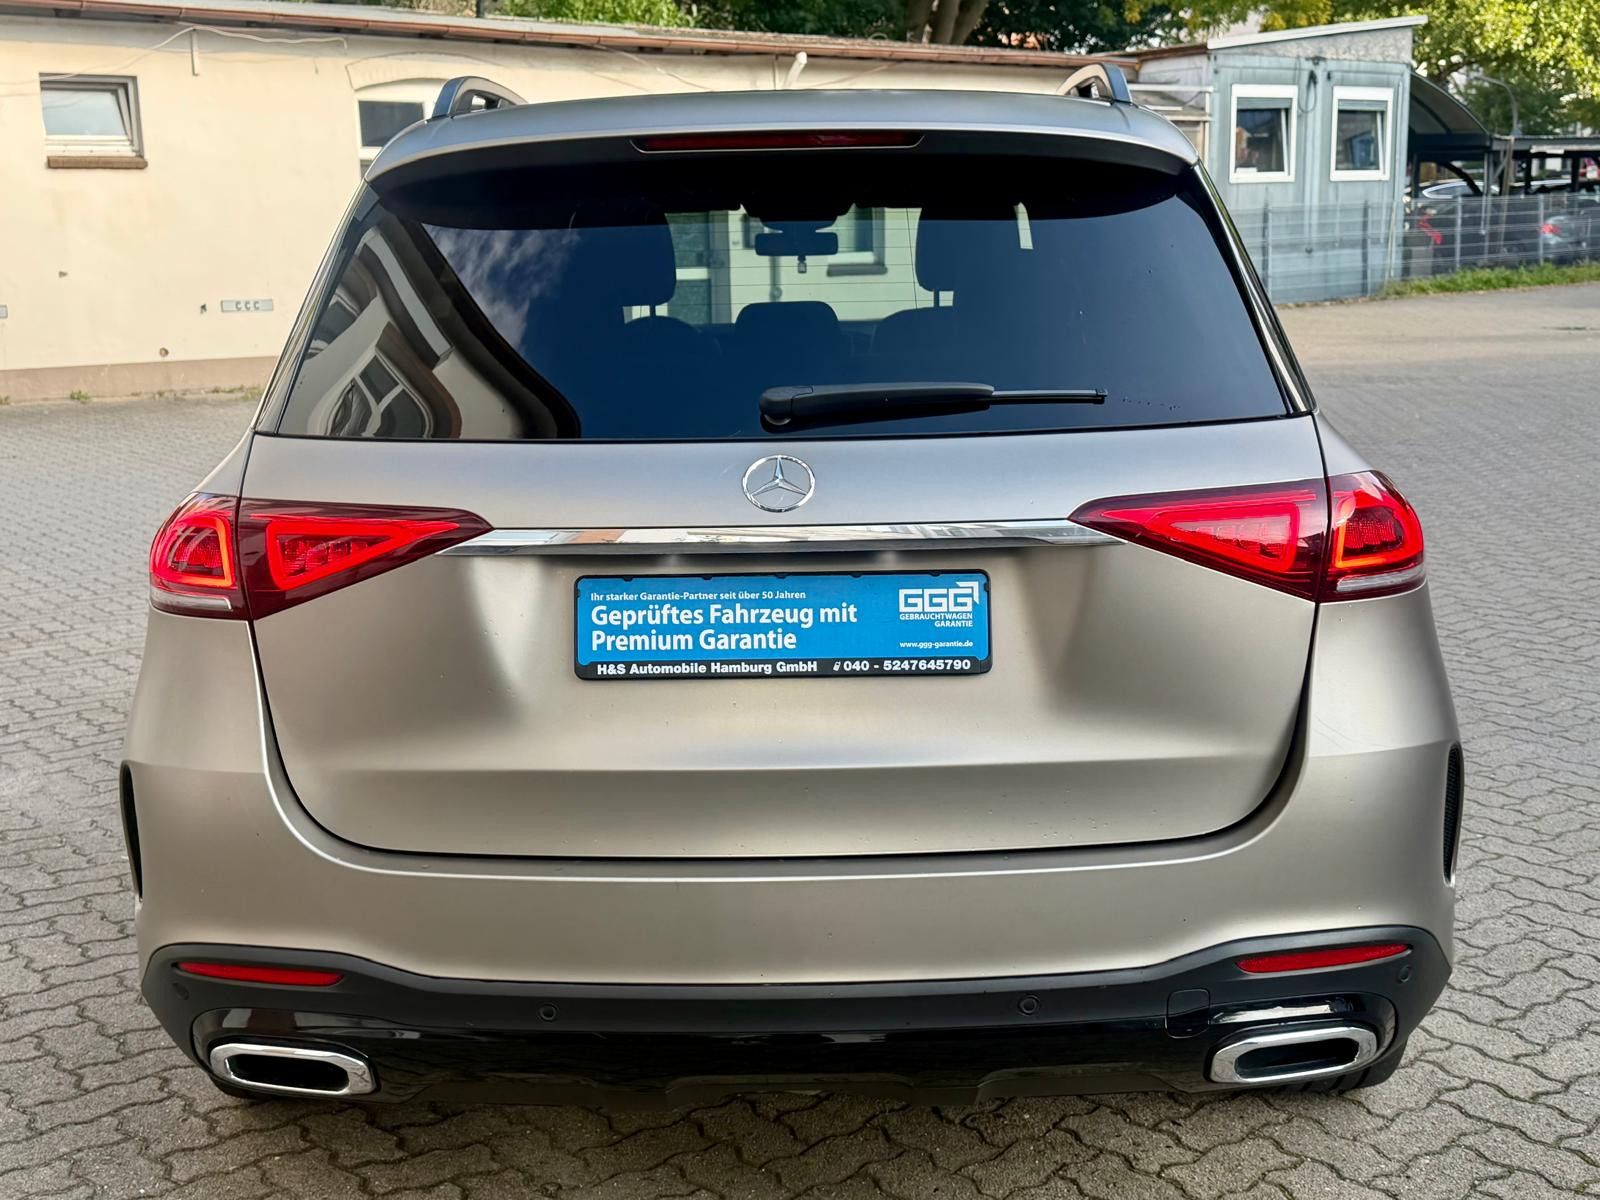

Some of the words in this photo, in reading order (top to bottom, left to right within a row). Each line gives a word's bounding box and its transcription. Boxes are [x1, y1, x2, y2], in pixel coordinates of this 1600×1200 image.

[590, 593, 604, 601] Ihr
[640, 592, 717, 600] Garantie-Partner
[720, 592, 737, 600] seit
[762, 591, 773, 599] 50
[774, 591, 806, 599] Jahren
[899, 588, 973, 613] GGG
[591, 604, 704, 630] Geprüftes
[709, 603, 814, 628] Fahrzeug
[819, 602, 858, 623] mit
[900, 612, 973, 620] GEBRAUCHTWAGEN
[934, 620, 974, 628] GARANTIE
[592, 630, 693, 651] Premium
[699, 627, 797, 650] Garantie
[900, 640, 974, 649] www.ggg-garantie.de
[597, 664, 626, 675] H&S
[629, 662, 707, 675] Automobile
[711, 662, 772, 675] Hamburg
[776, 660, 818, 672] GmbH
[843, 660, 870, 672] 040
[883, 659, 971, 670] 5247645790
